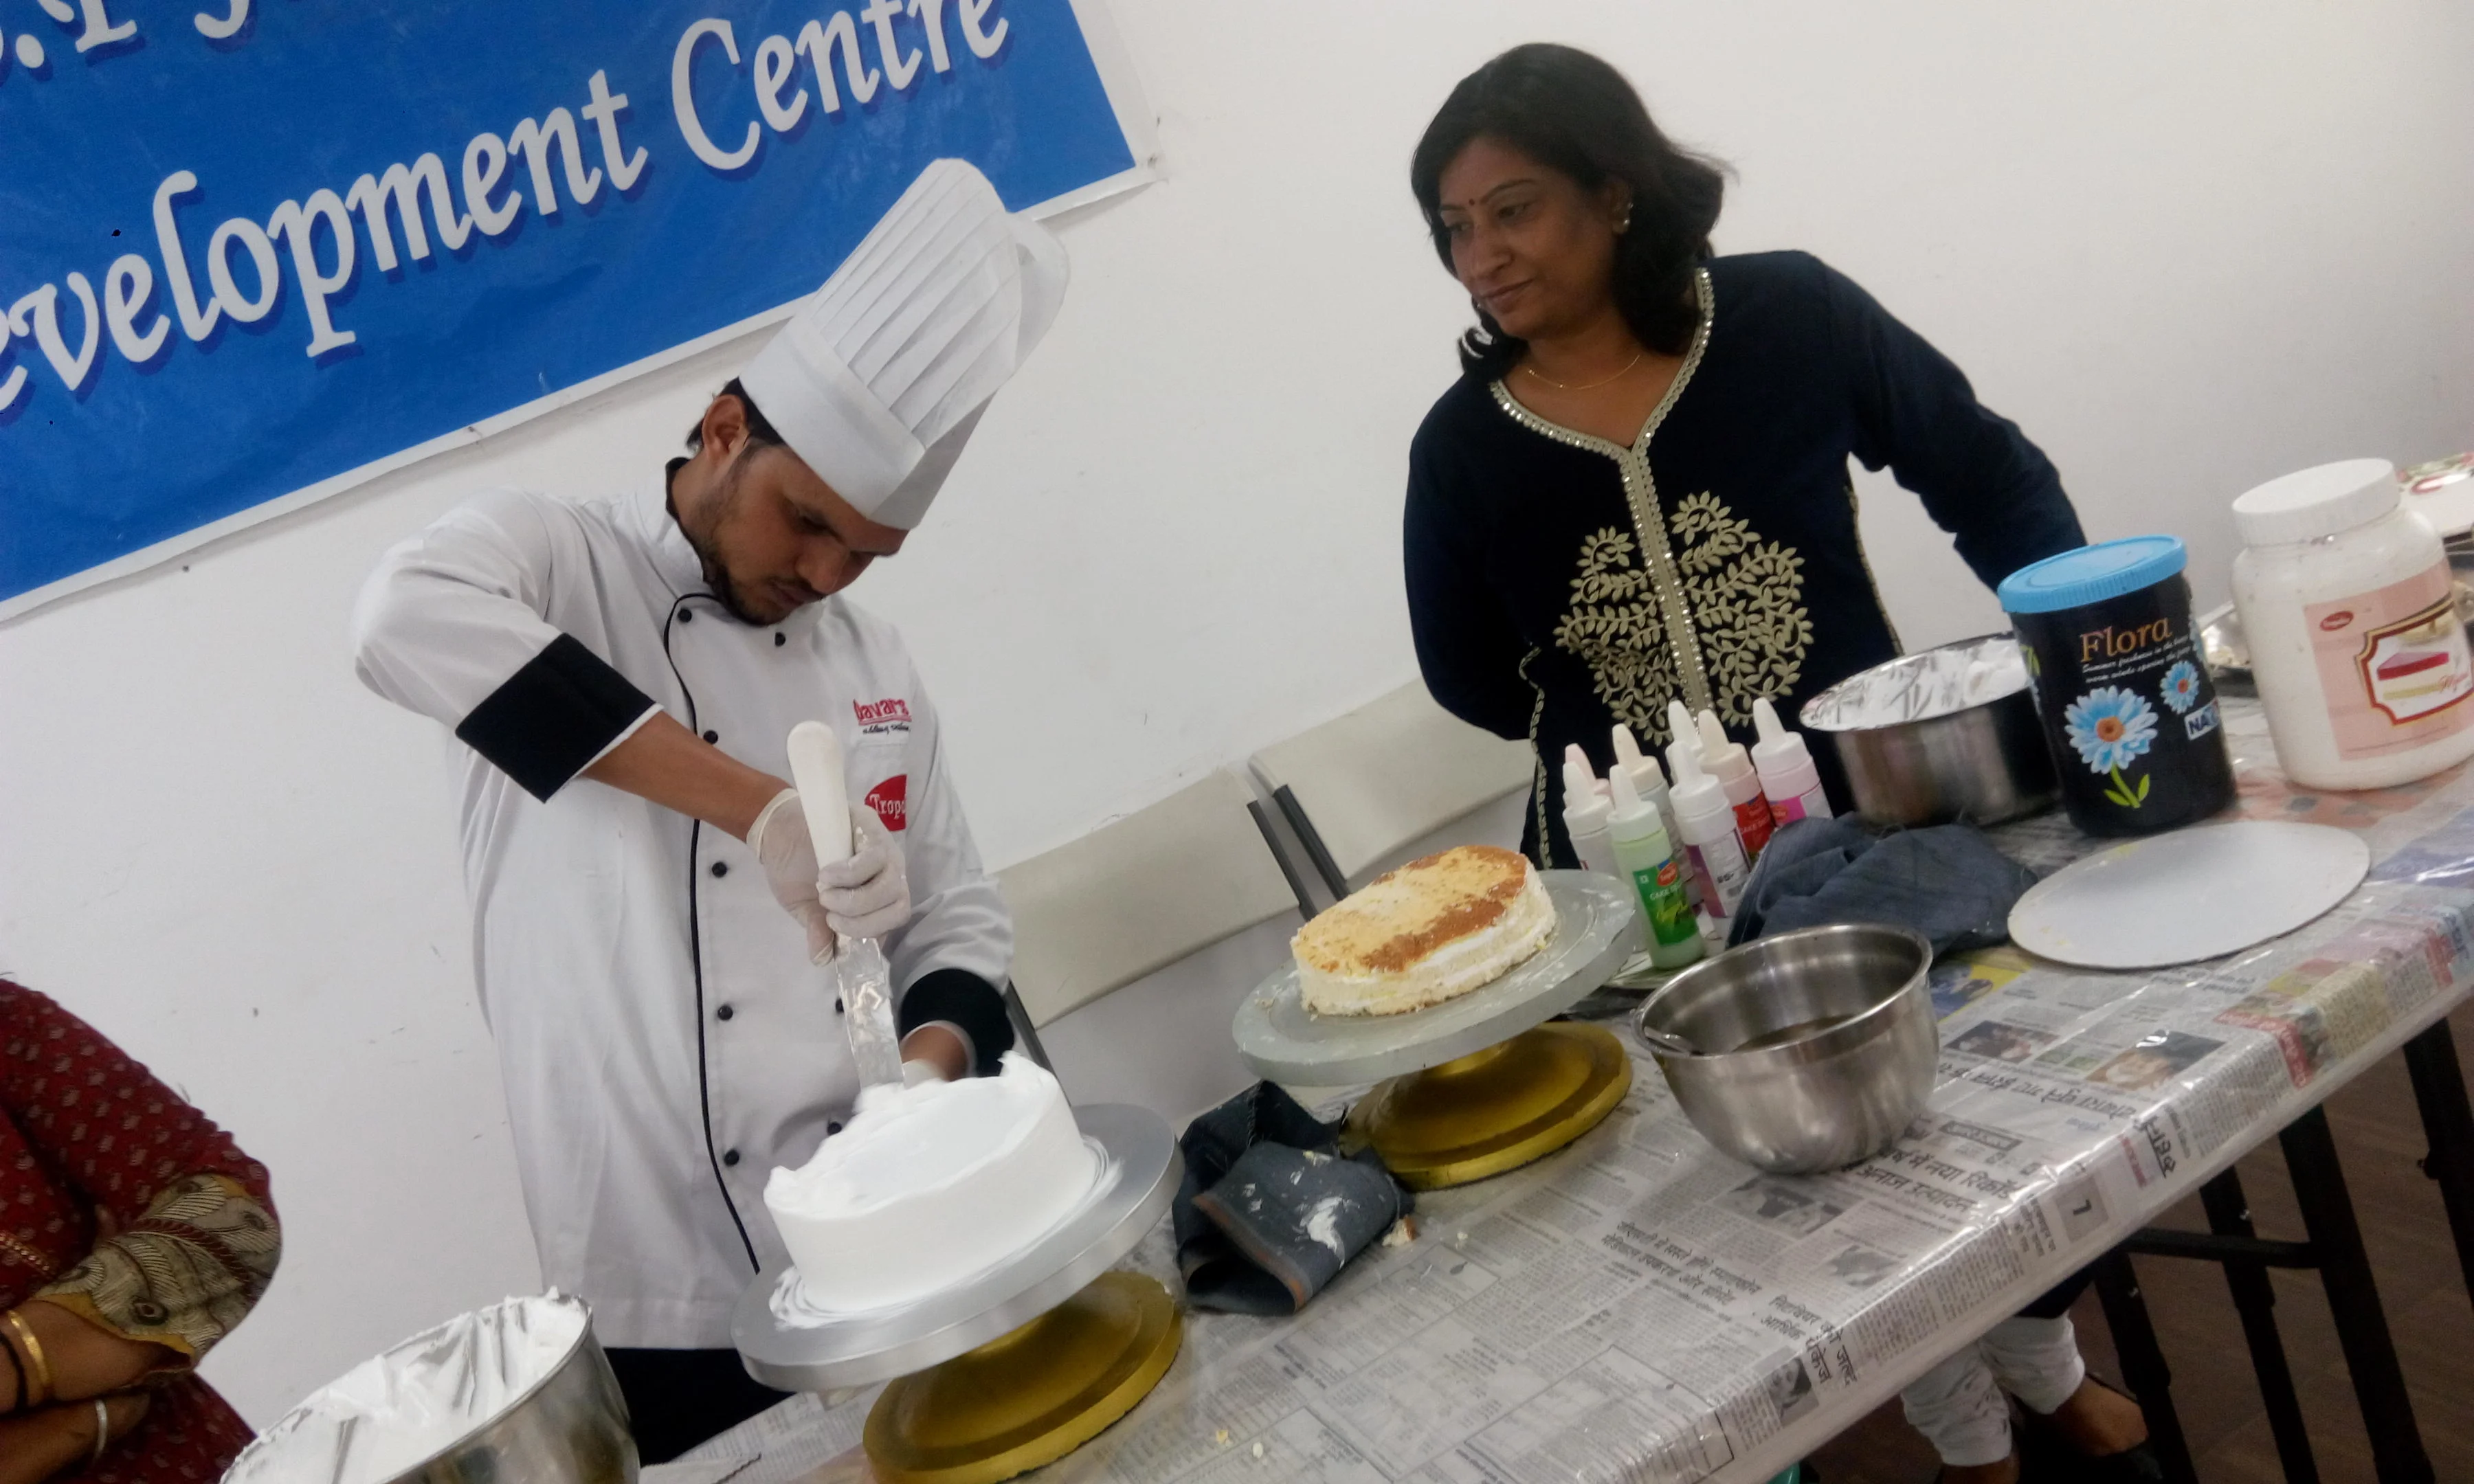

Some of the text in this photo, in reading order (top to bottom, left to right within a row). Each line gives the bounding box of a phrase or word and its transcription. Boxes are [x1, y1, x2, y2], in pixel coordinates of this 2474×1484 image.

[671, 0, 1009, 170] Centre
[2080, 618, 2174, 664] Flora
[1855, 1165, 1913, 1190] अनाज
[1925, 1160, 1968, 1182] नया
